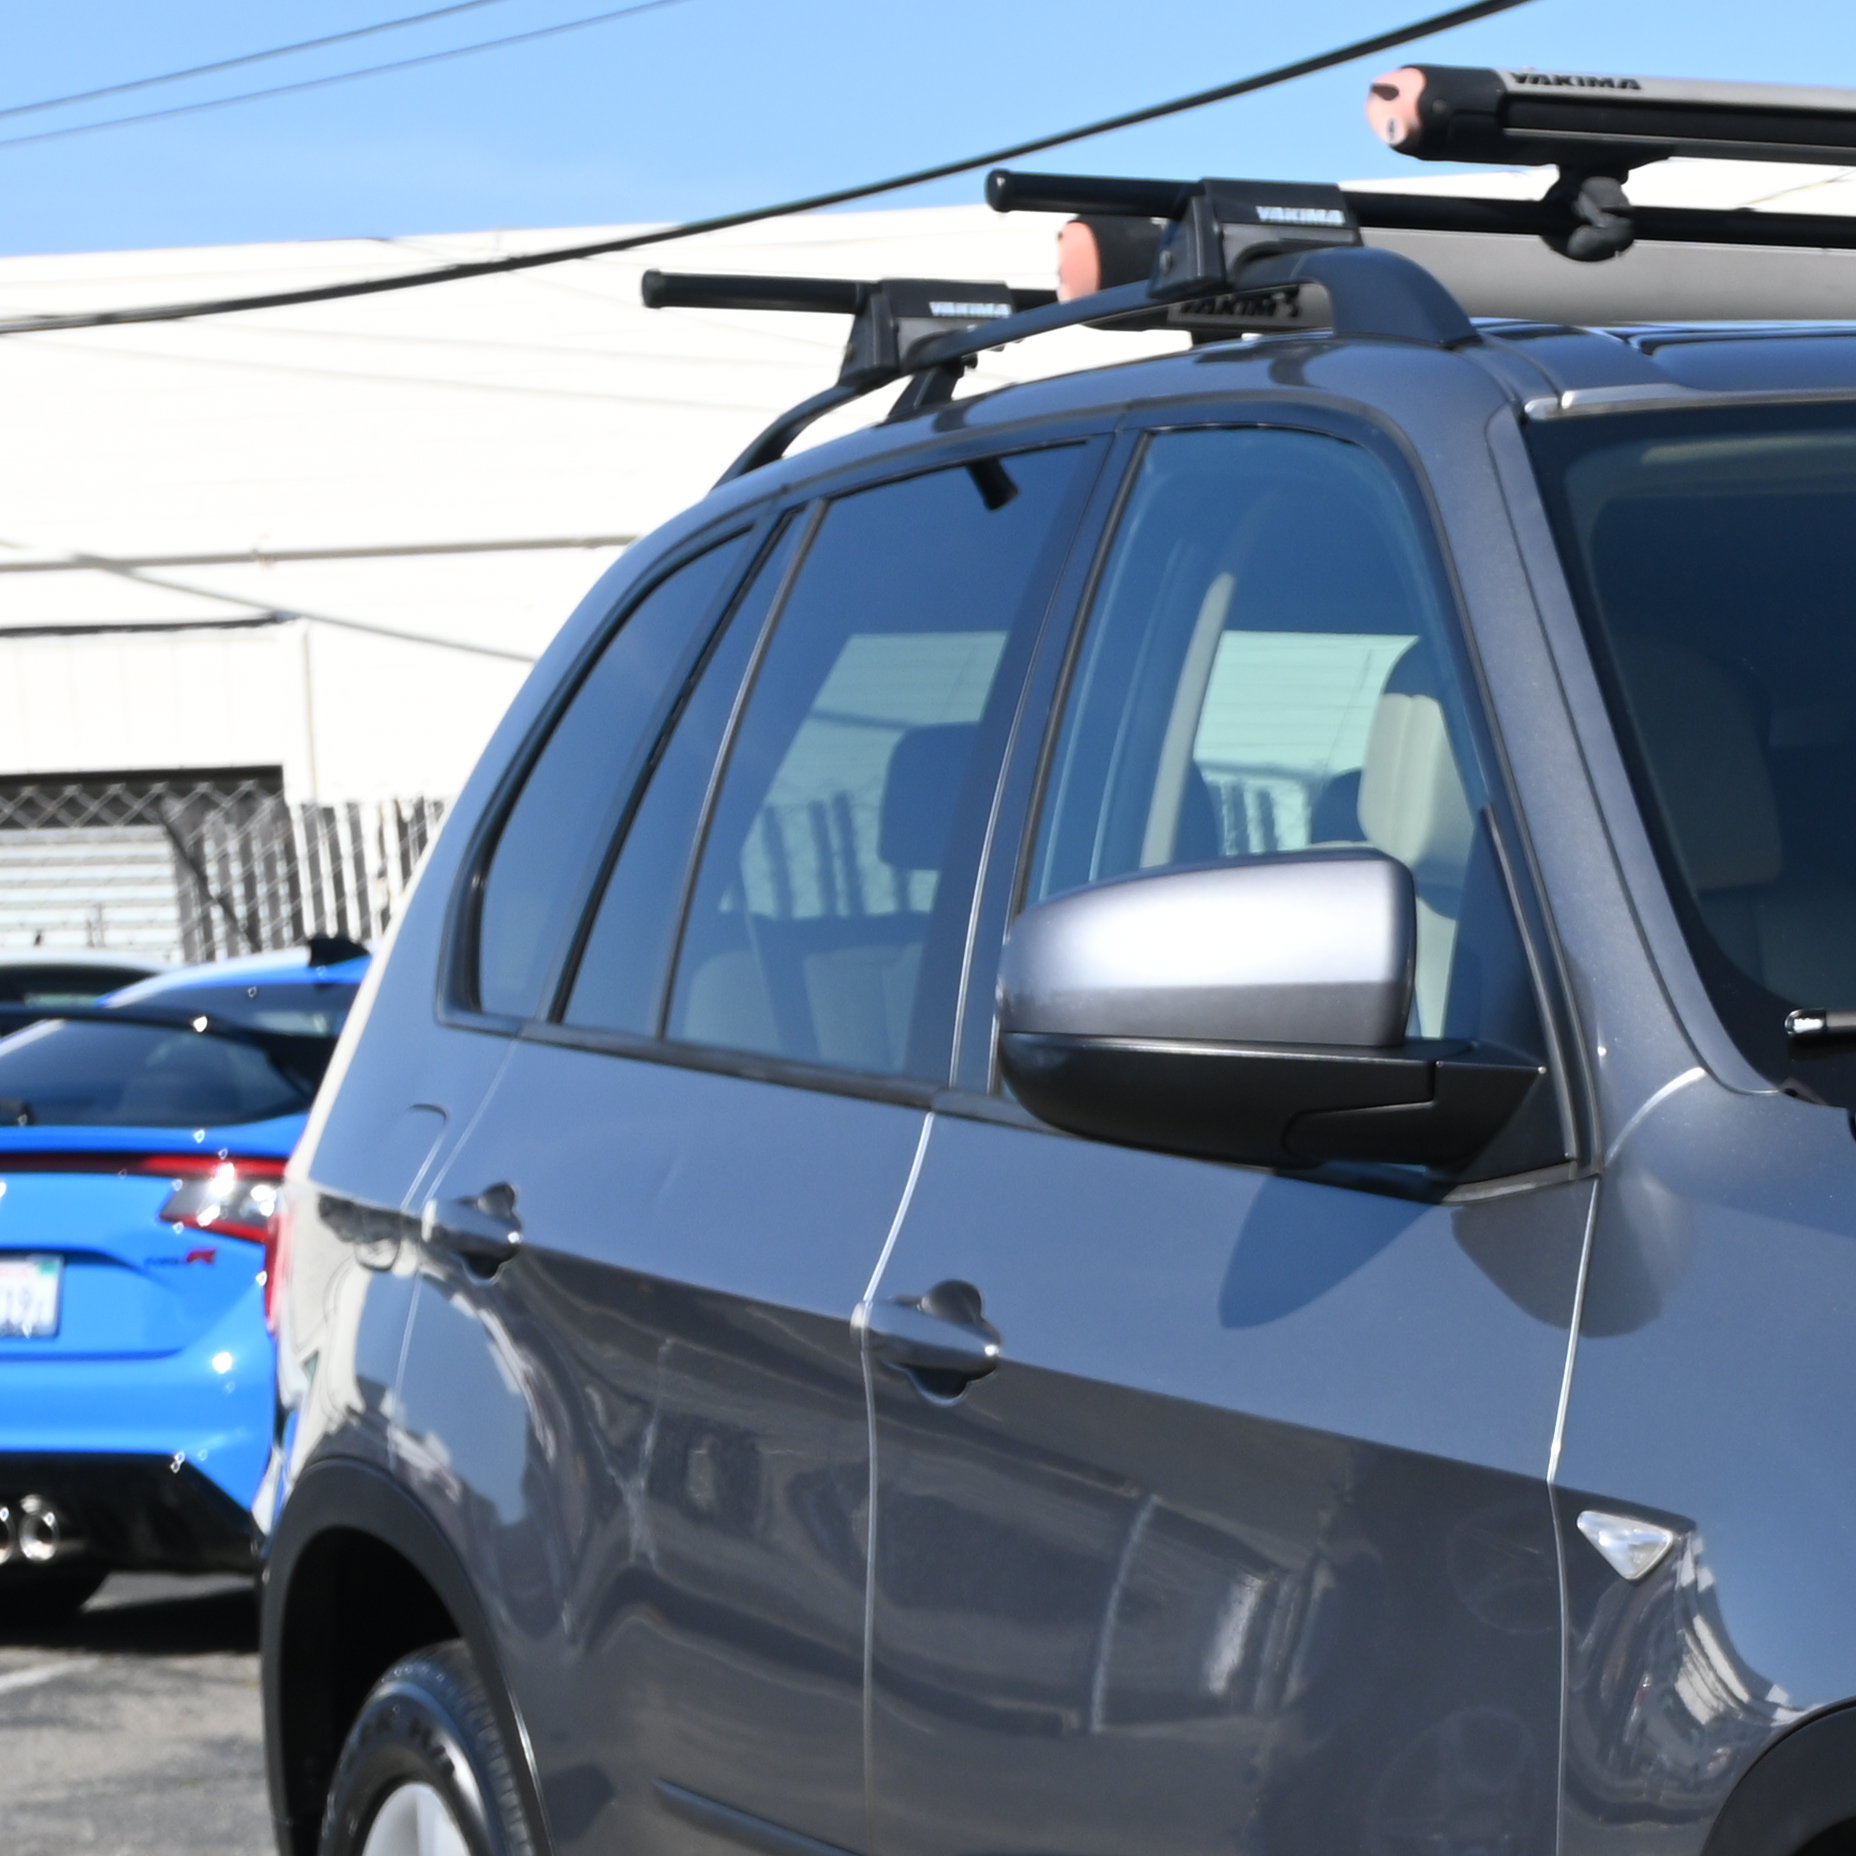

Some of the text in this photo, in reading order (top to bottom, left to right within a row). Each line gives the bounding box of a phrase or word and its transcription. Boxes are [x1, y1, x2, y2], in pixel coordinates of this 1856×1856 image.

[1510, 72, 1642, 91] YAKIMA
[1254, 206, 1347, 226] YAKIMA
[927, 301, 1012, 319] YAKIMA
